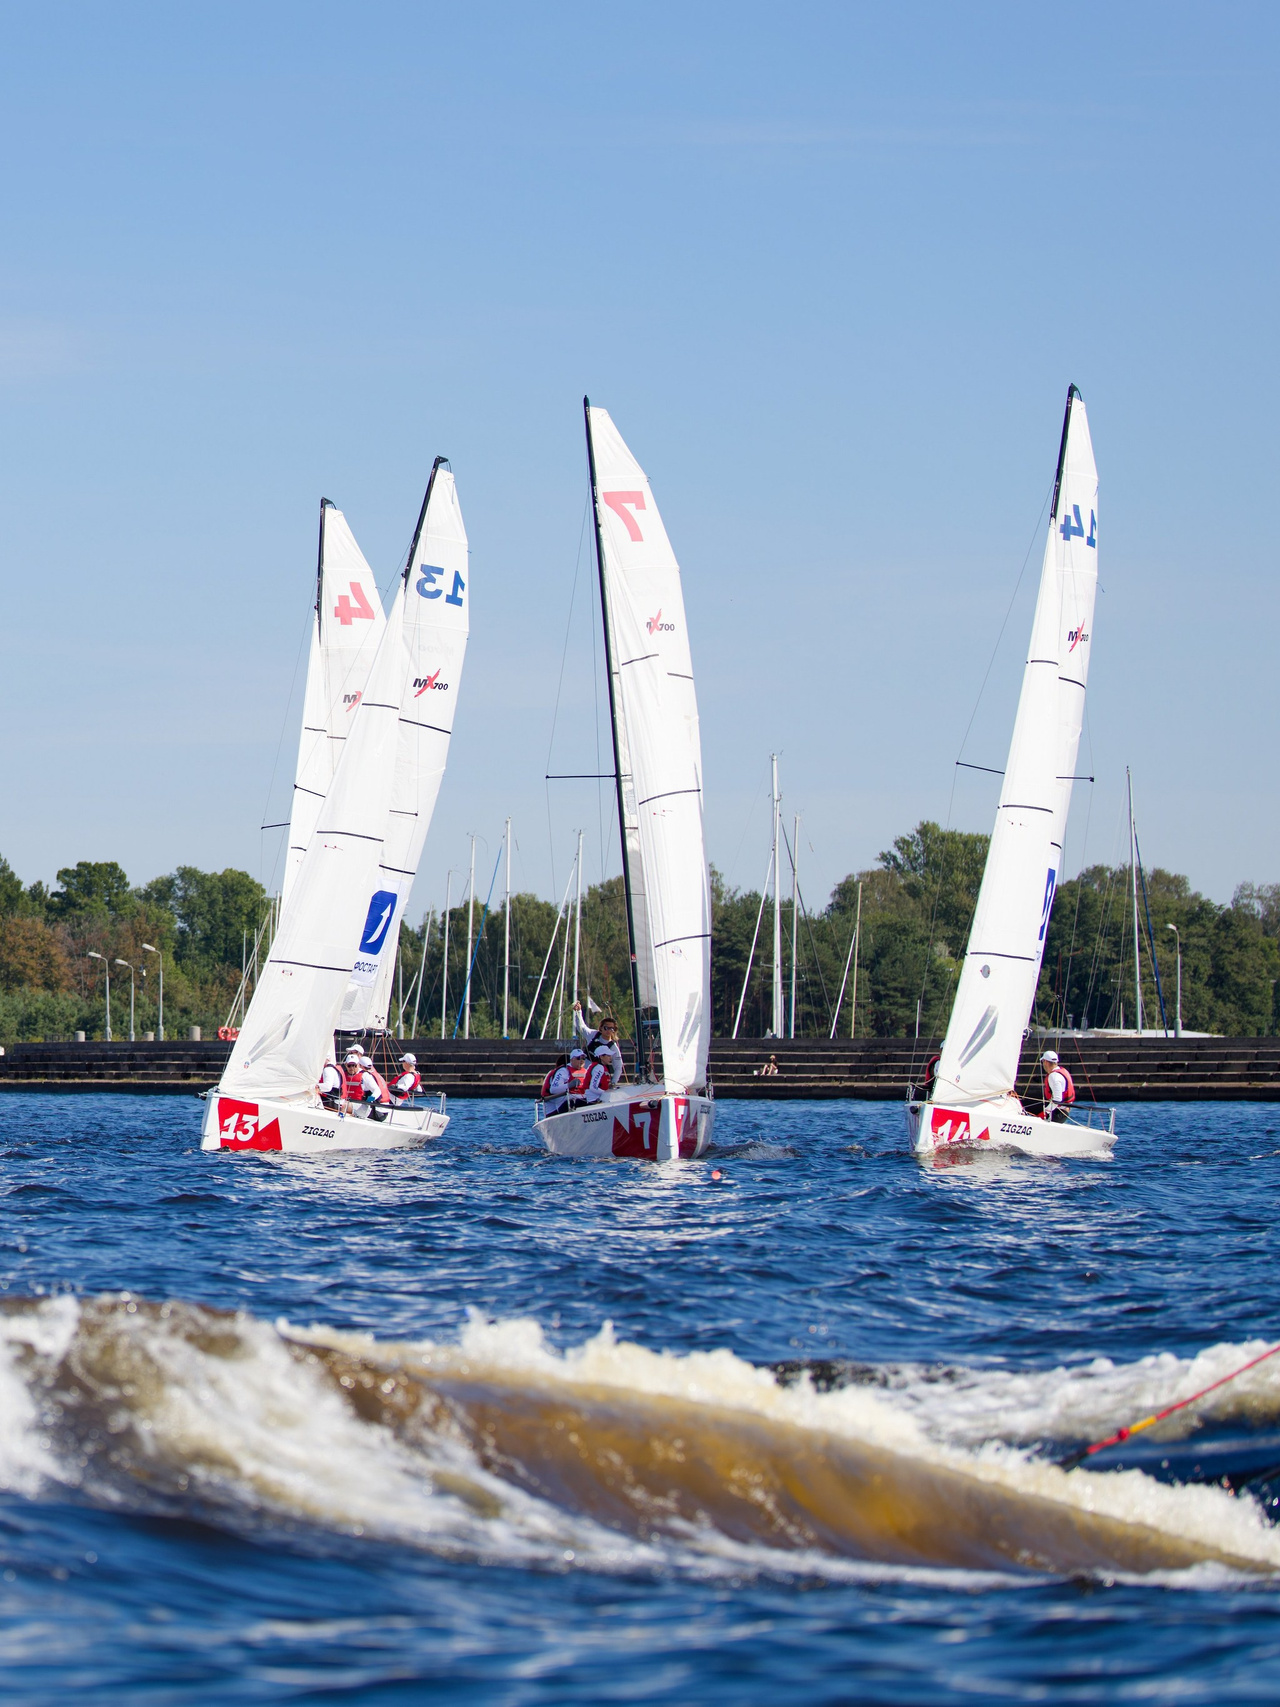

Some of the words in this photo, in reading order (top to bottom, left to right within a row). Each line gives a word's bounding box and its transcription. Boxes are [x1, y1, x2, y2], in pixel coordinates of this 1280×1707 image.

[412, 667, 449, 698] MX700
[220, 1111, 260, 1142] 13
[581, 1111, 608, 1124] ZIGZAG
[301, 1125, 336, 1139] ZIGZAG
[632, 1112, 652, 1150] 7
[1000, 1122, 1033, 1136] ZIGZAG
